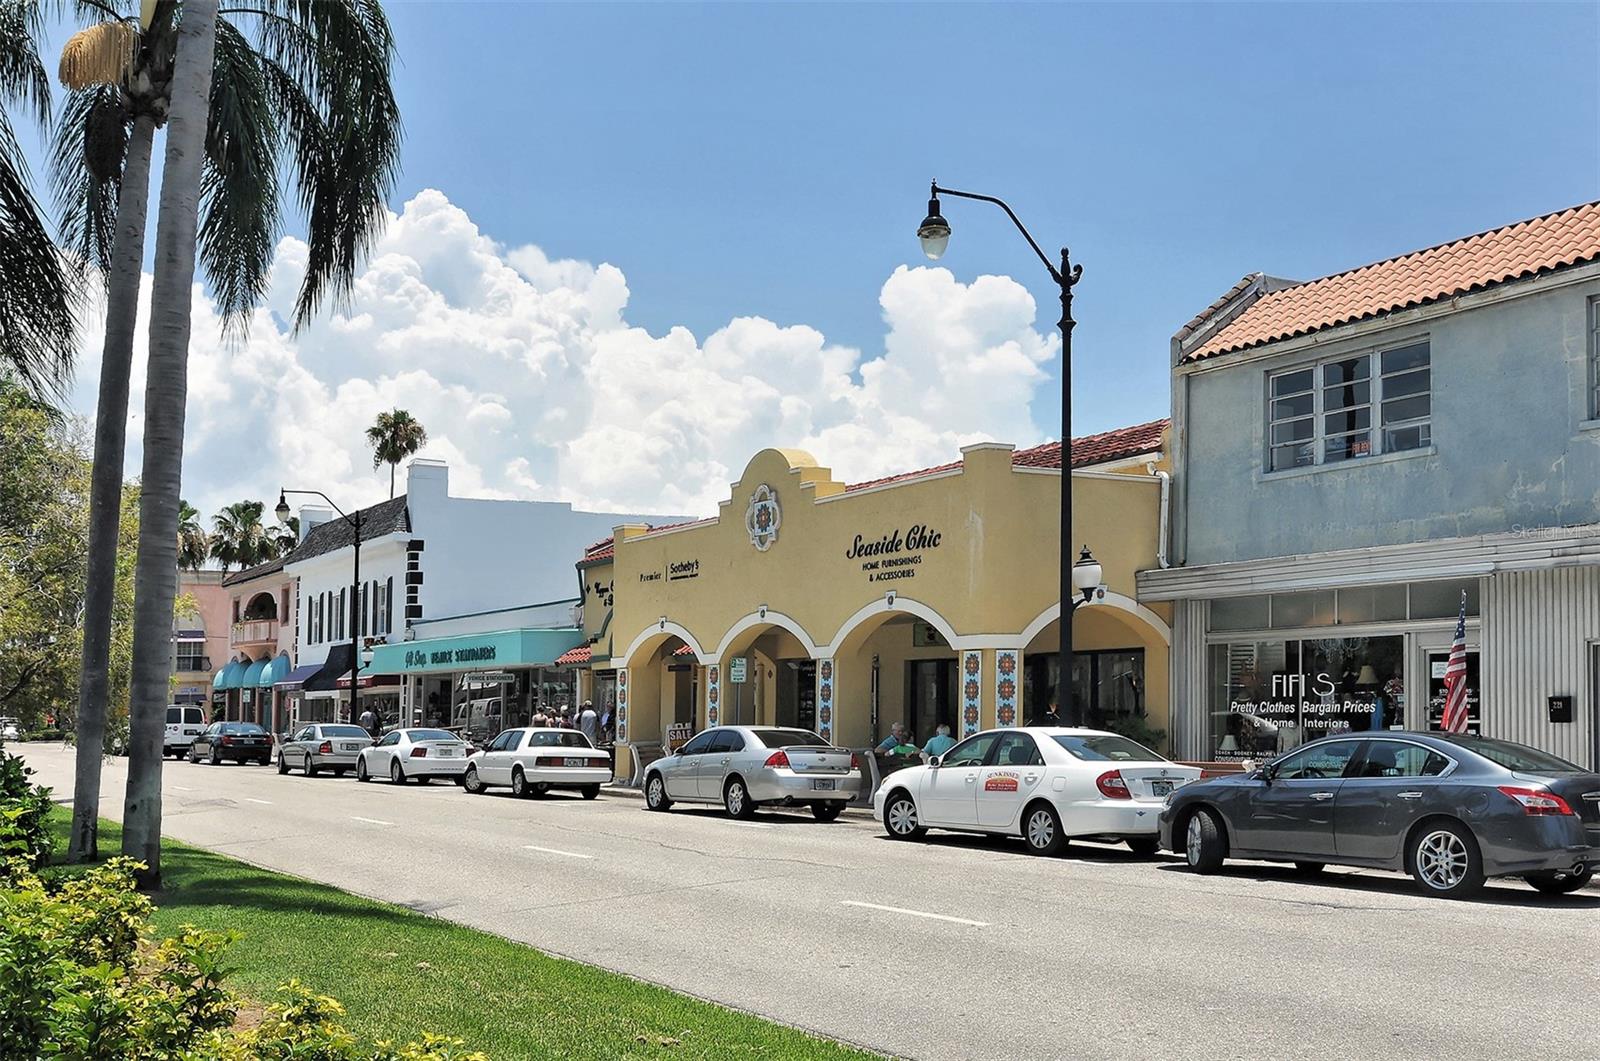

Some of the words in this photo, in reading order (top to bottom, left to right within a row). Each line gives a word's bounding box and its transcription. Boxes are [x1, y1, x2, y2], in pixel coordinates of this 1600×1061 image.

[846, 529, 902, 559] Seaside
[905, 525, 942, 550] Chic
[639, 572, 661, 582] Premier
[670, 559, 699, 574] Sotheby's
[862, 561, 879, 571] HOME
[881, 555, 922, 568] FURNISHINGS
[869, 574, 874, 582] &
[875, 569, 915, 581] ACCESSORIES
[1272, 672, 1335, 697] FIFI'S
[1230, 701, 1257, 715] Pretty
[1259, 701, 1296, 713] Clothes
[1302, 701, 1341, 715] Bargain
[1343, 700, 1376, 713] Prices
[1253, 719, 1261, 728] &
[1265, 718, 1294, 728] Home
[1304, 718, 1350, 728] Interiors
[669, 729, 692, 740] SALE
